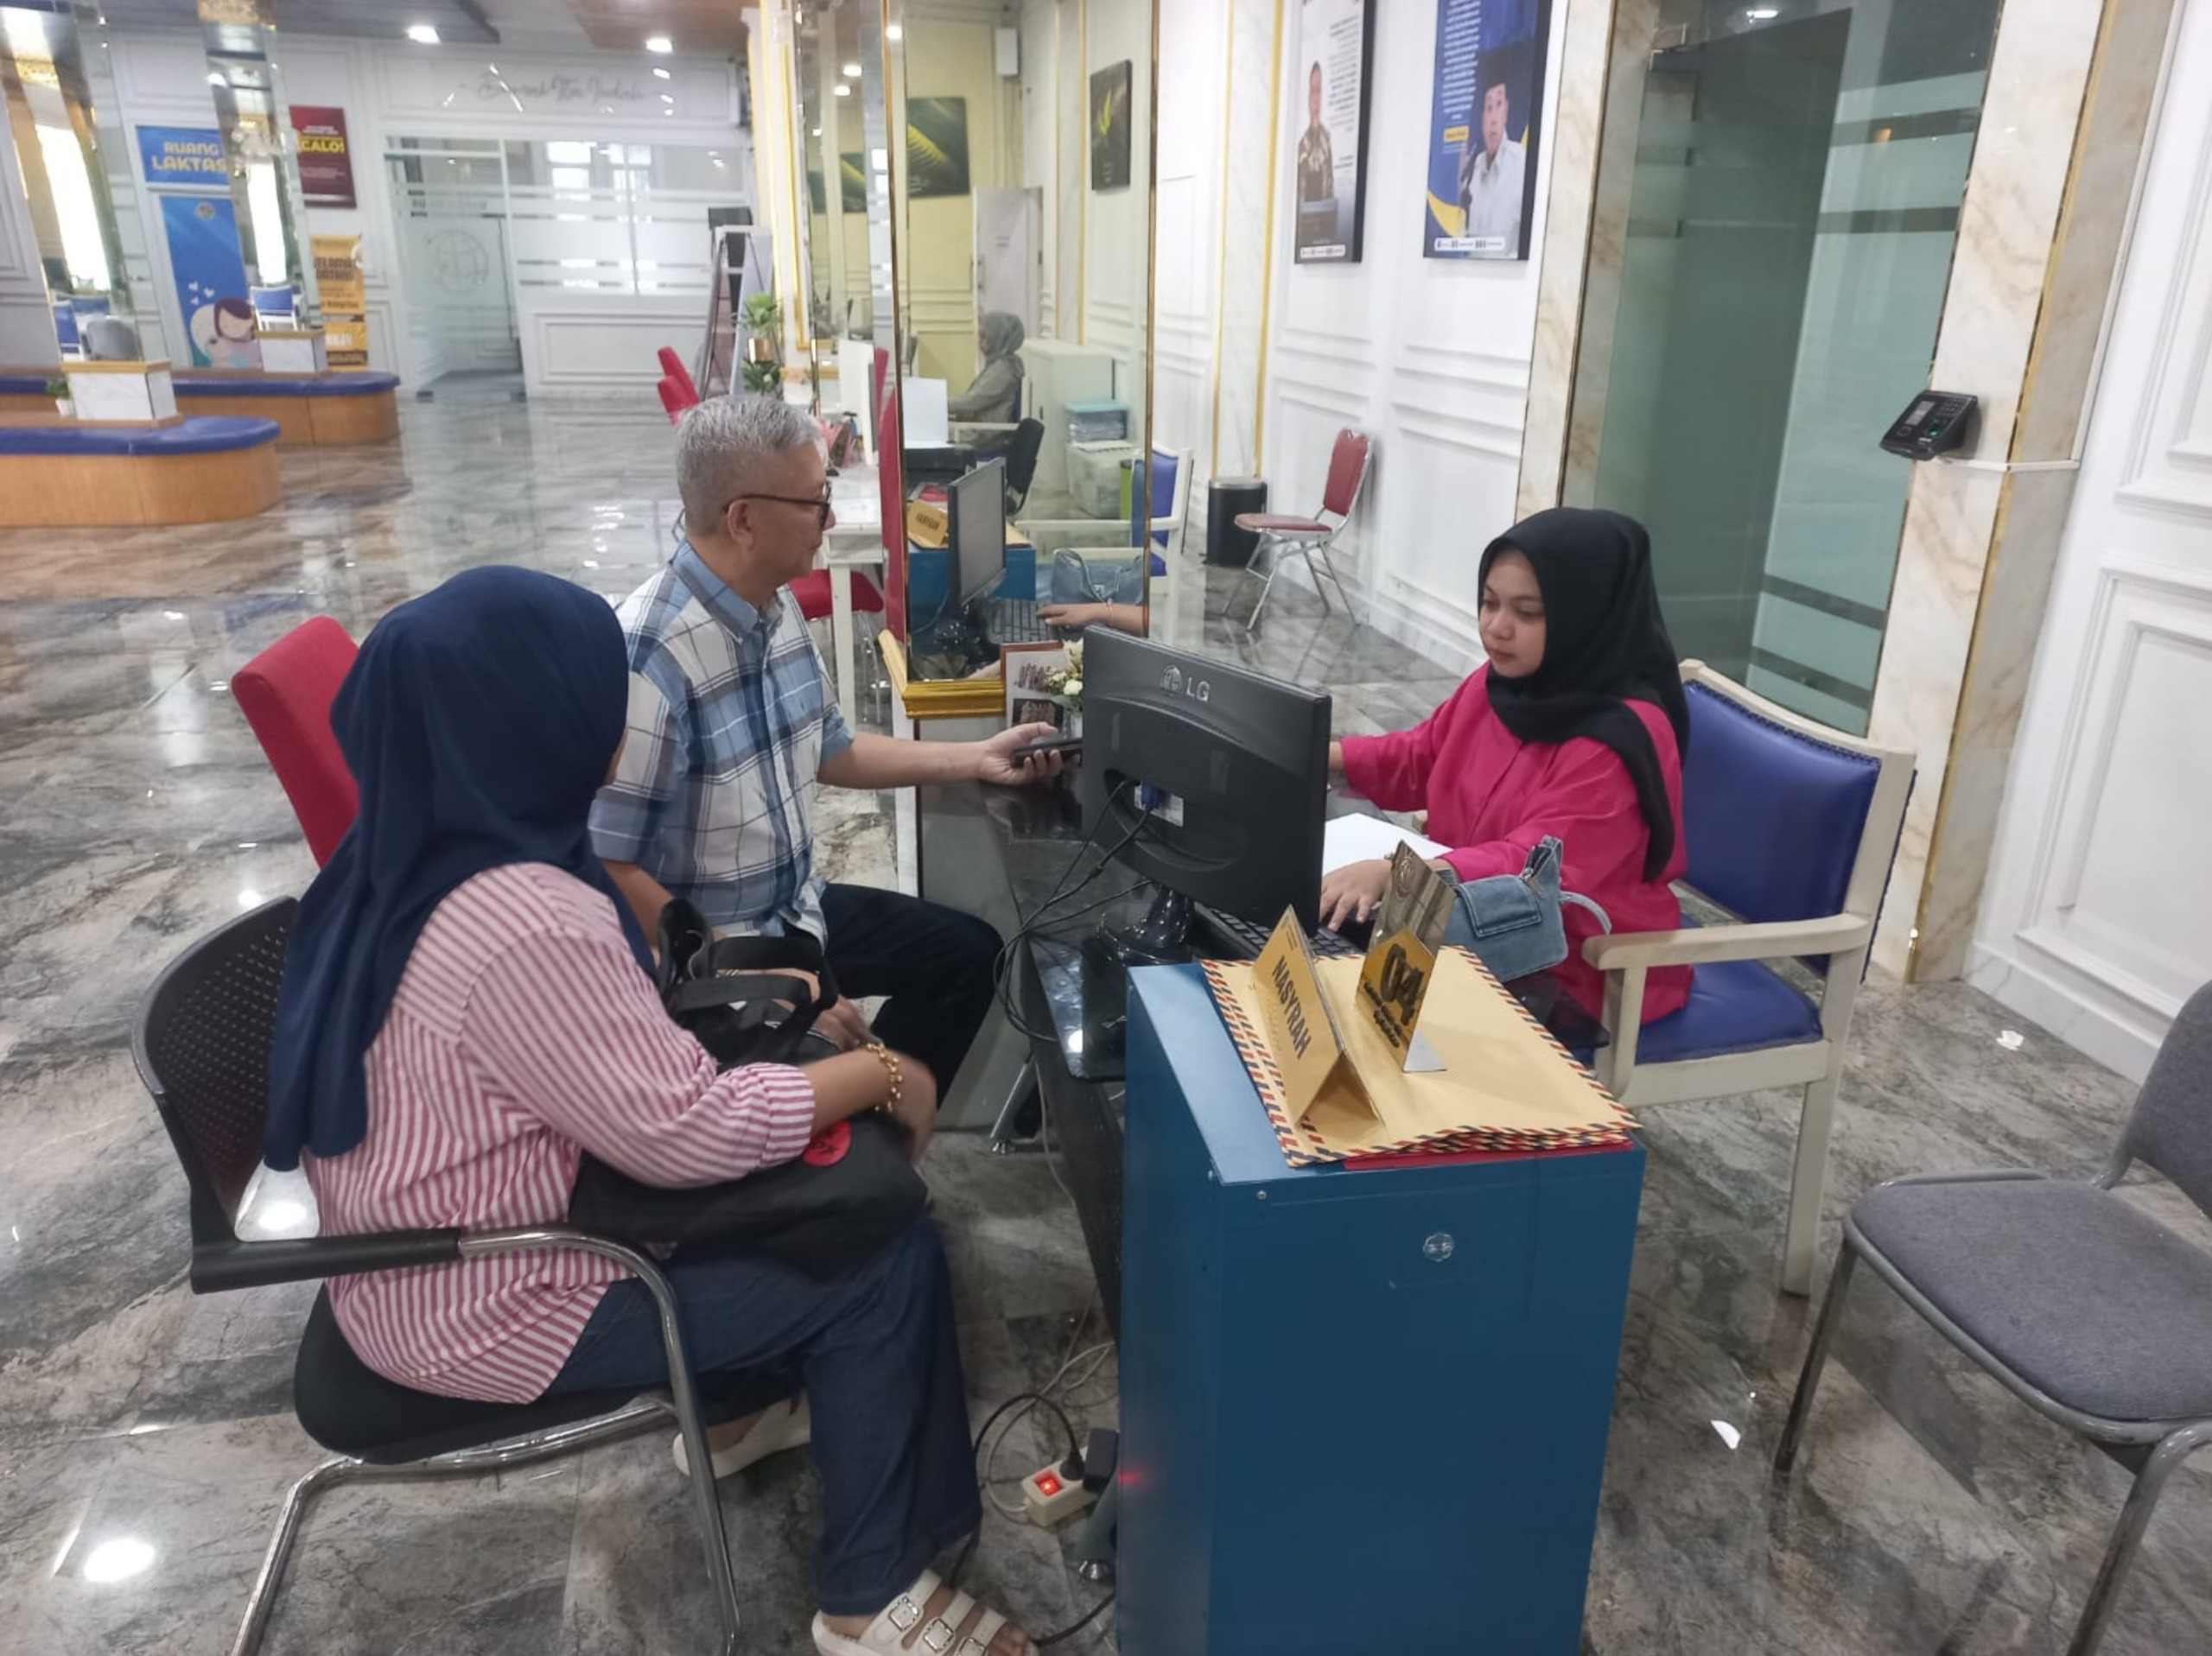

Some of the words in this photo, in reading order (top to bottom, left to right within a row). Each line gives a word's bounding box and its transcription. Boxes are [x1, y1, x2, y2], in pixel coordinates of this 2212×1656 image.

[164, 141, 219, 155] RUANG
[1186, 676, 1210, 702] LG
[1272, 955, 1312, 1060] NASYRAH
[1380, 943, 1426, 1026] 04
